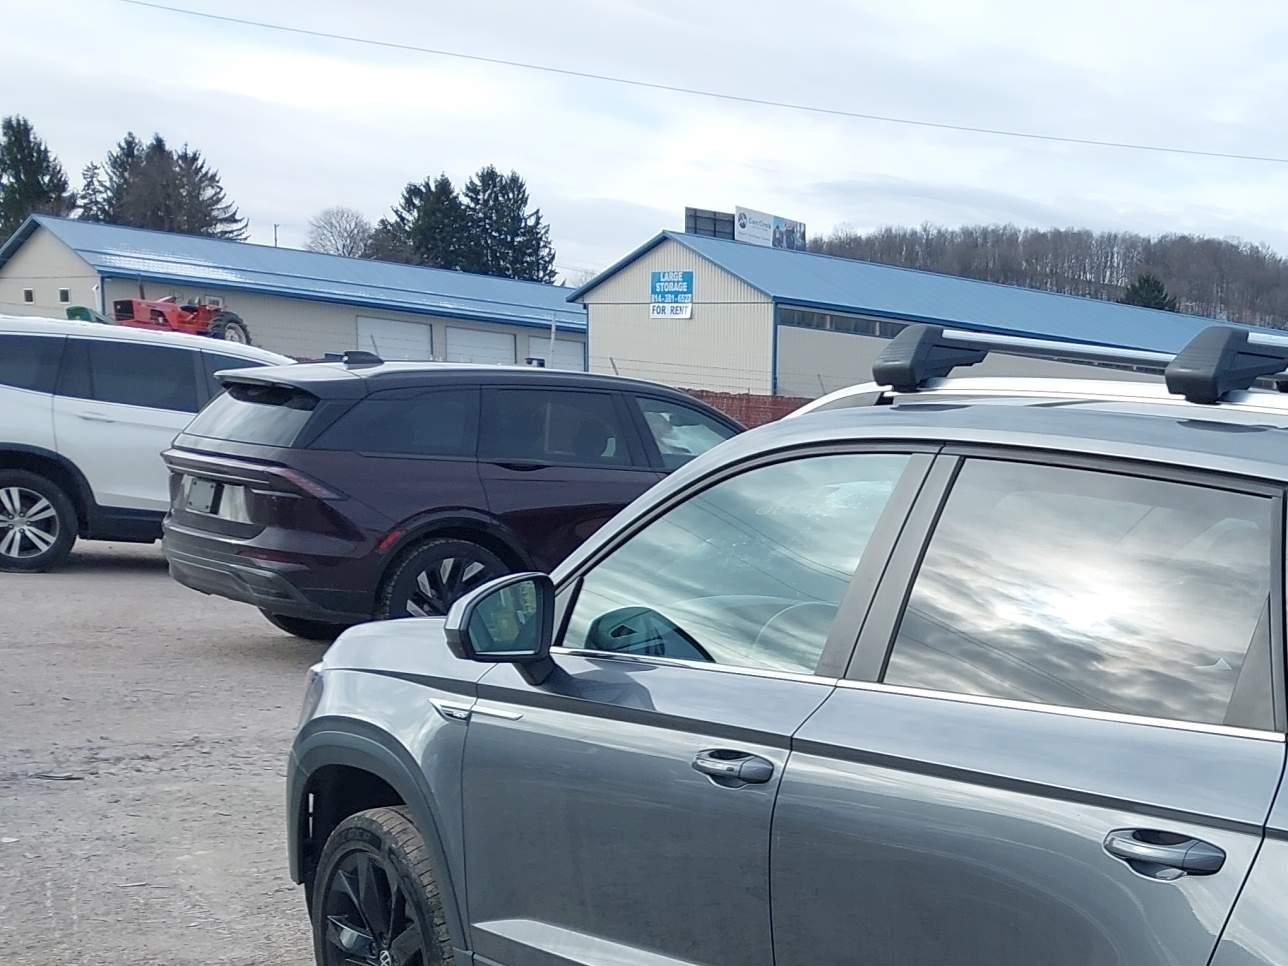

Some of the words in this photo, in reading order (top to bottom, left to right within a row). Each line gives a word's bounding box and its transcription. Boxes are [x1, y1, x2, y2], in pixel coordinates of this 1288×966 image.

[660, 272, 683, 281] LARGE
[656, 282, 688, 292] STORAGE
[652, 305, 666, 315] FOR
[670, 305, 688, 315] RENT
